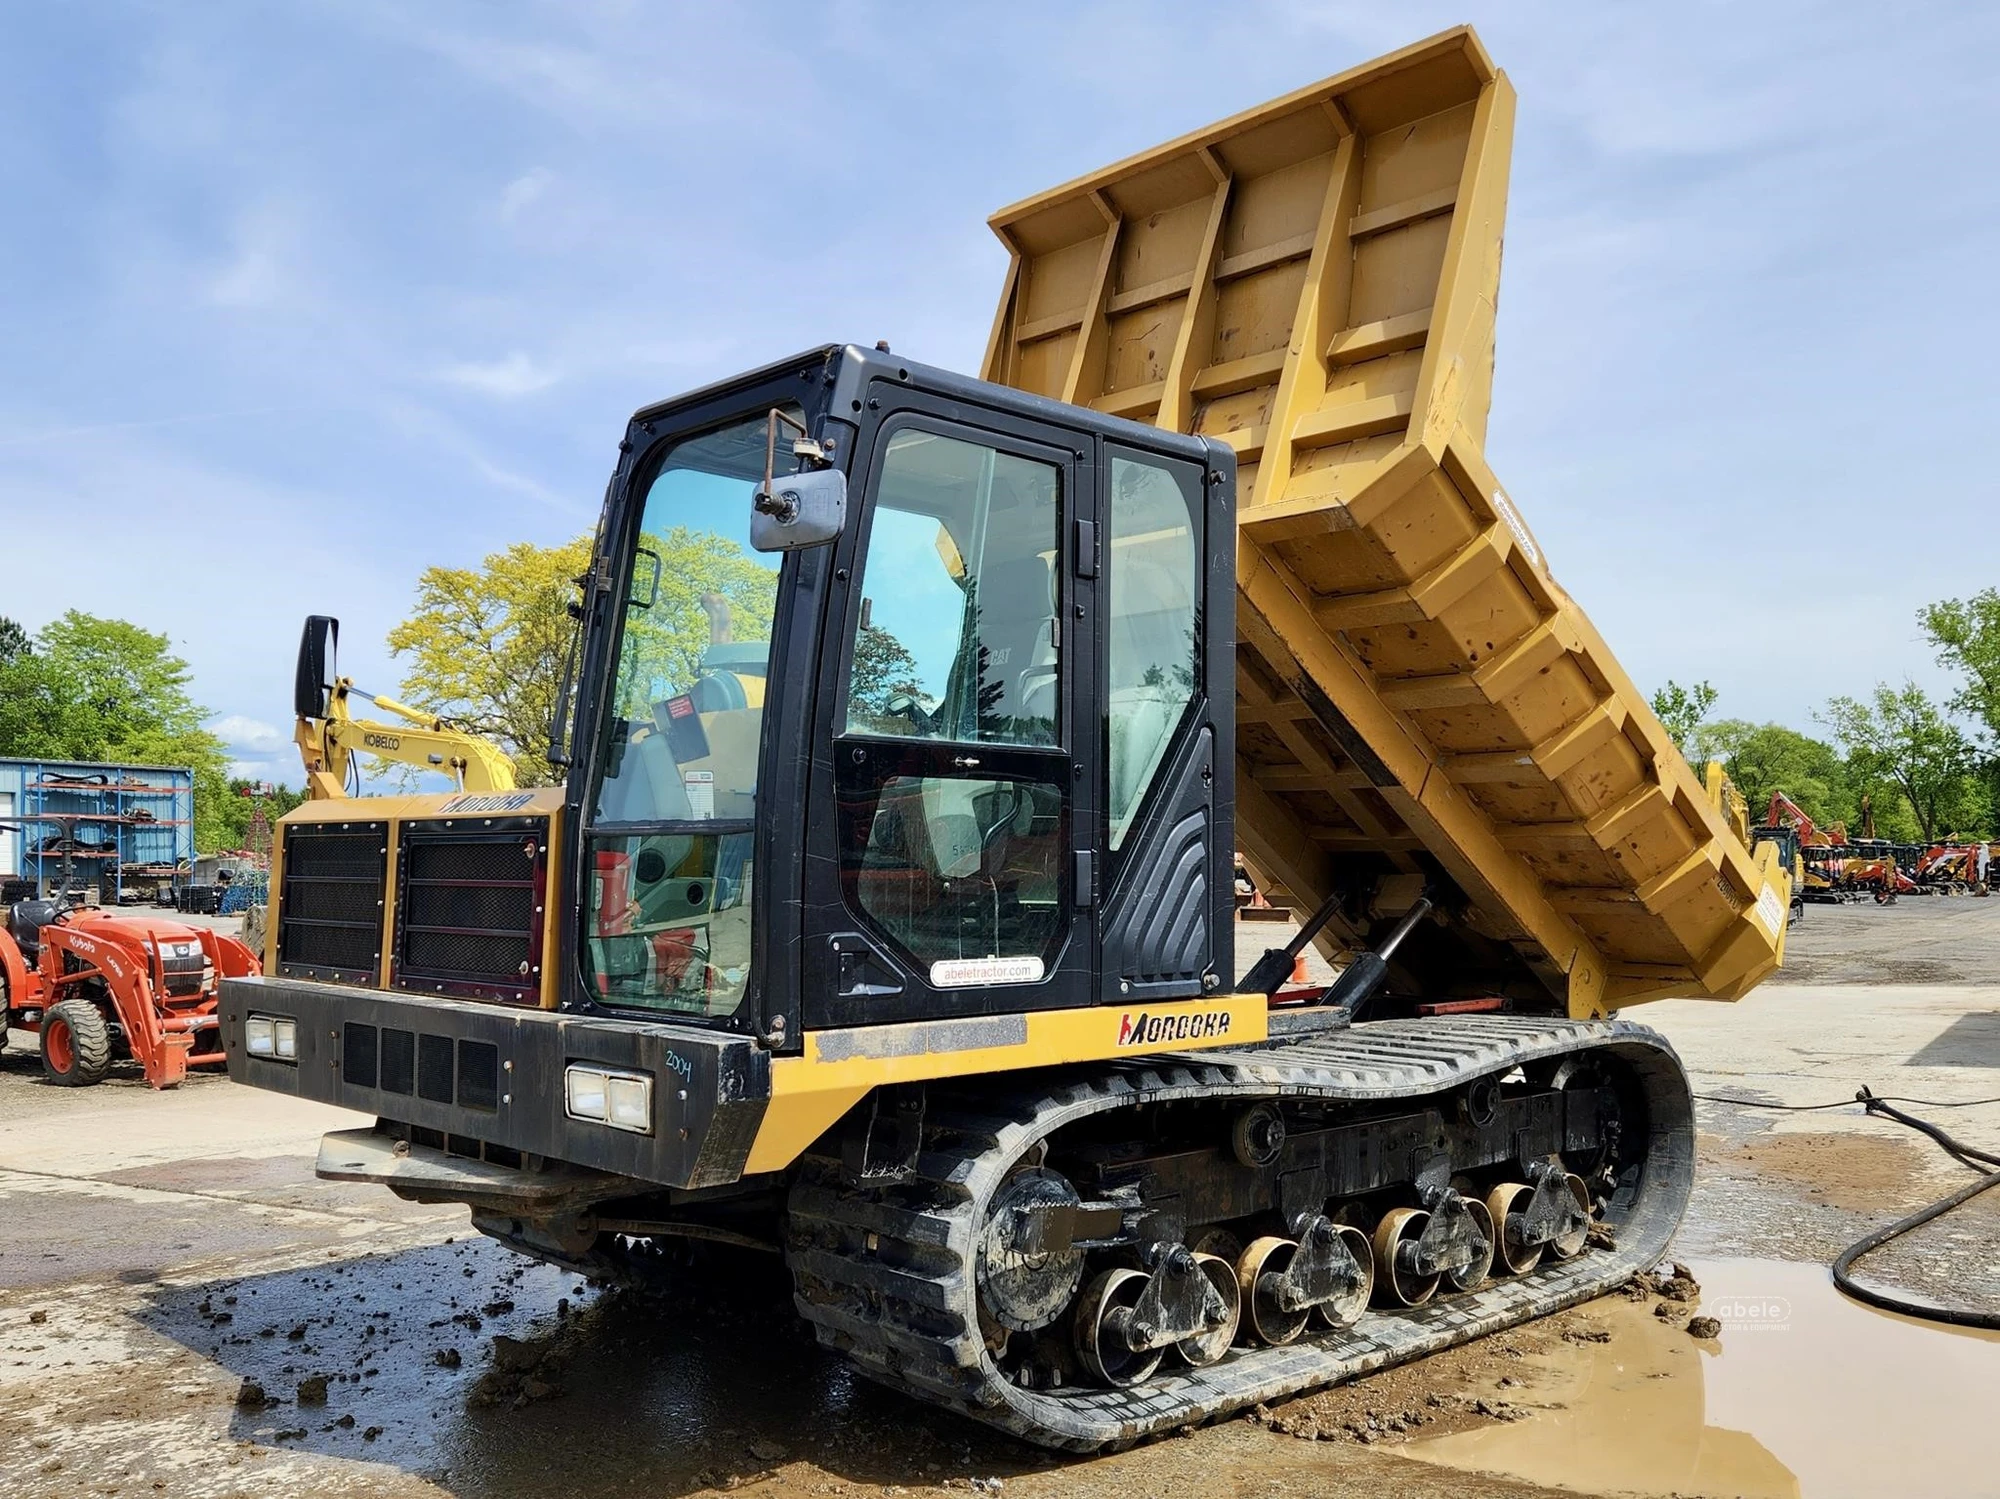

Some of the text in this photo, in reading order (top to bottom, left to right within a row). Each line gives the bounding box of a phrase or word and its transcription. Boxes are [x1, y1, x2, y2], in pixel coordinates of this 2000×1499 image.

[364, 733, 400, 751] KOBELCO
[438, 794, 535, 813] MOROOKA
[69, 934, 96, 954] Kubota
[944, 966, 1031, 980] abeletractor.com
[1118, 1011, 1231, 1046] MOROOKA
[665, 1050, 692, 1083] 2004
